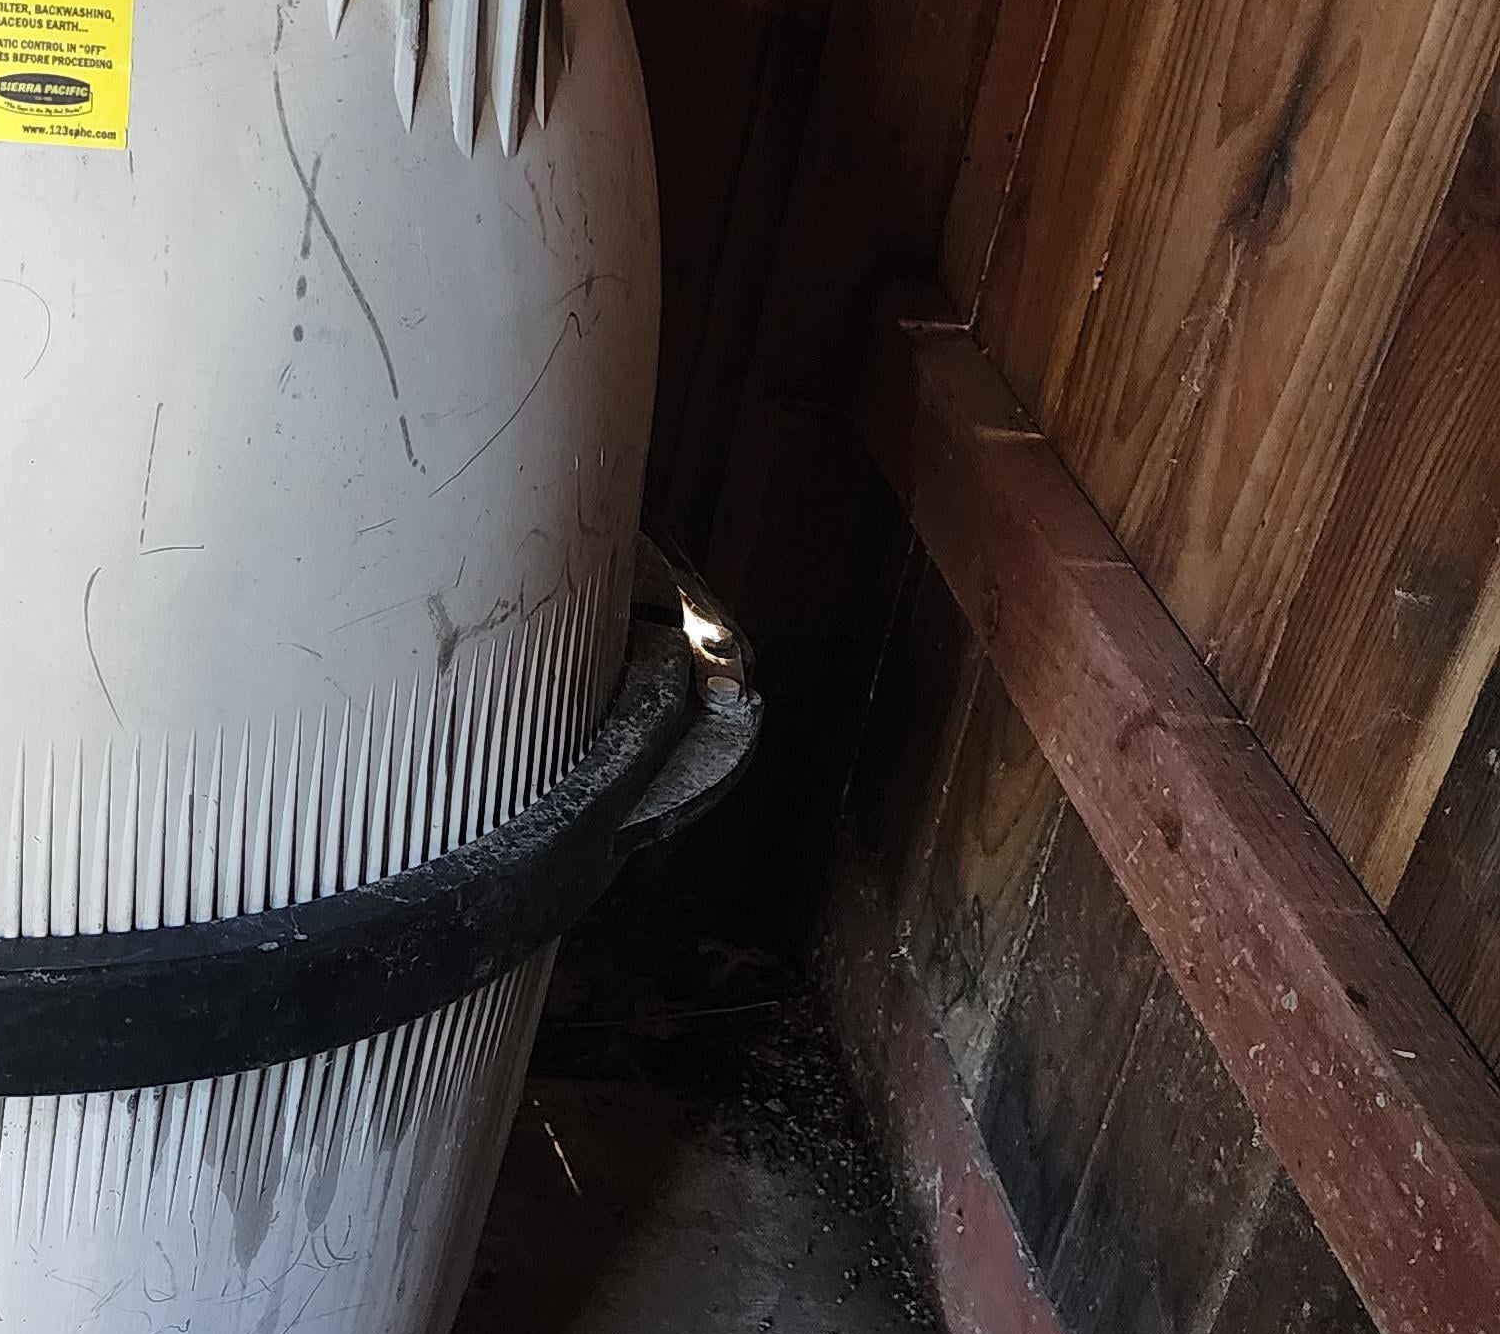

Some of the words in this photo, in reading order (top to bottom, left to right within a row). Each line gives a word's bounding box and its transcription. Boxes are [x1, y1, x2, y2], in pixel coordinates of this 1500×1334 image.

[35, 5, 115, 22] BACKWASHING,
[46, 19, 89, 33] EARTH...
[20, 40, 64, 52] CONTROL
[66, 43, 76, 53] IN
[12, 53, 49, 64] BEFORE
[52, 55, 113, 69] PROCEEDING
[0, 81, 42, 94] SIERRA
[44, 85, 89, 97] PACIFIC
